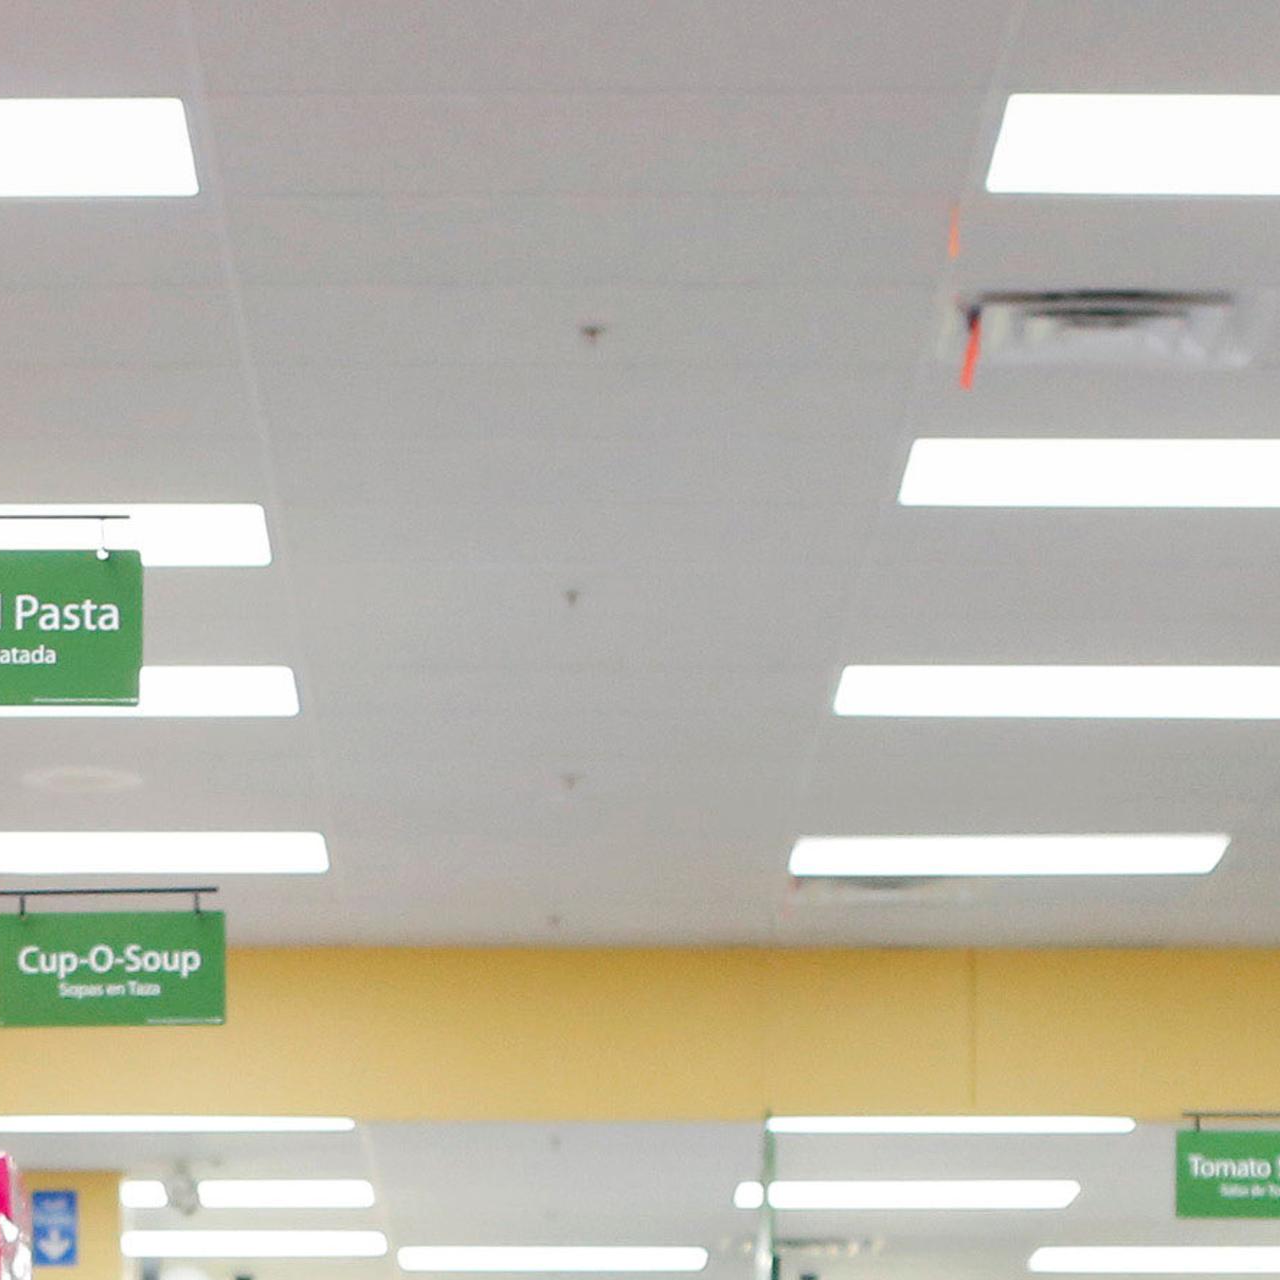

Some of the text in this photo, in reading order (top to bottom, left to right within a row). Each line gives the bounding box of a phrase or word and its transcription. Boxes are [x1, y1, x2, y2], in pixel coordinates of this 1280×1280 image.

[15, 595, 120, 631] Pasta
[17, 944, 202, 979] Cup-O-Soup
[58, 980, 161, 999] Sopas en Taza
[1188, 1154, 1271, 1179] Tomato
